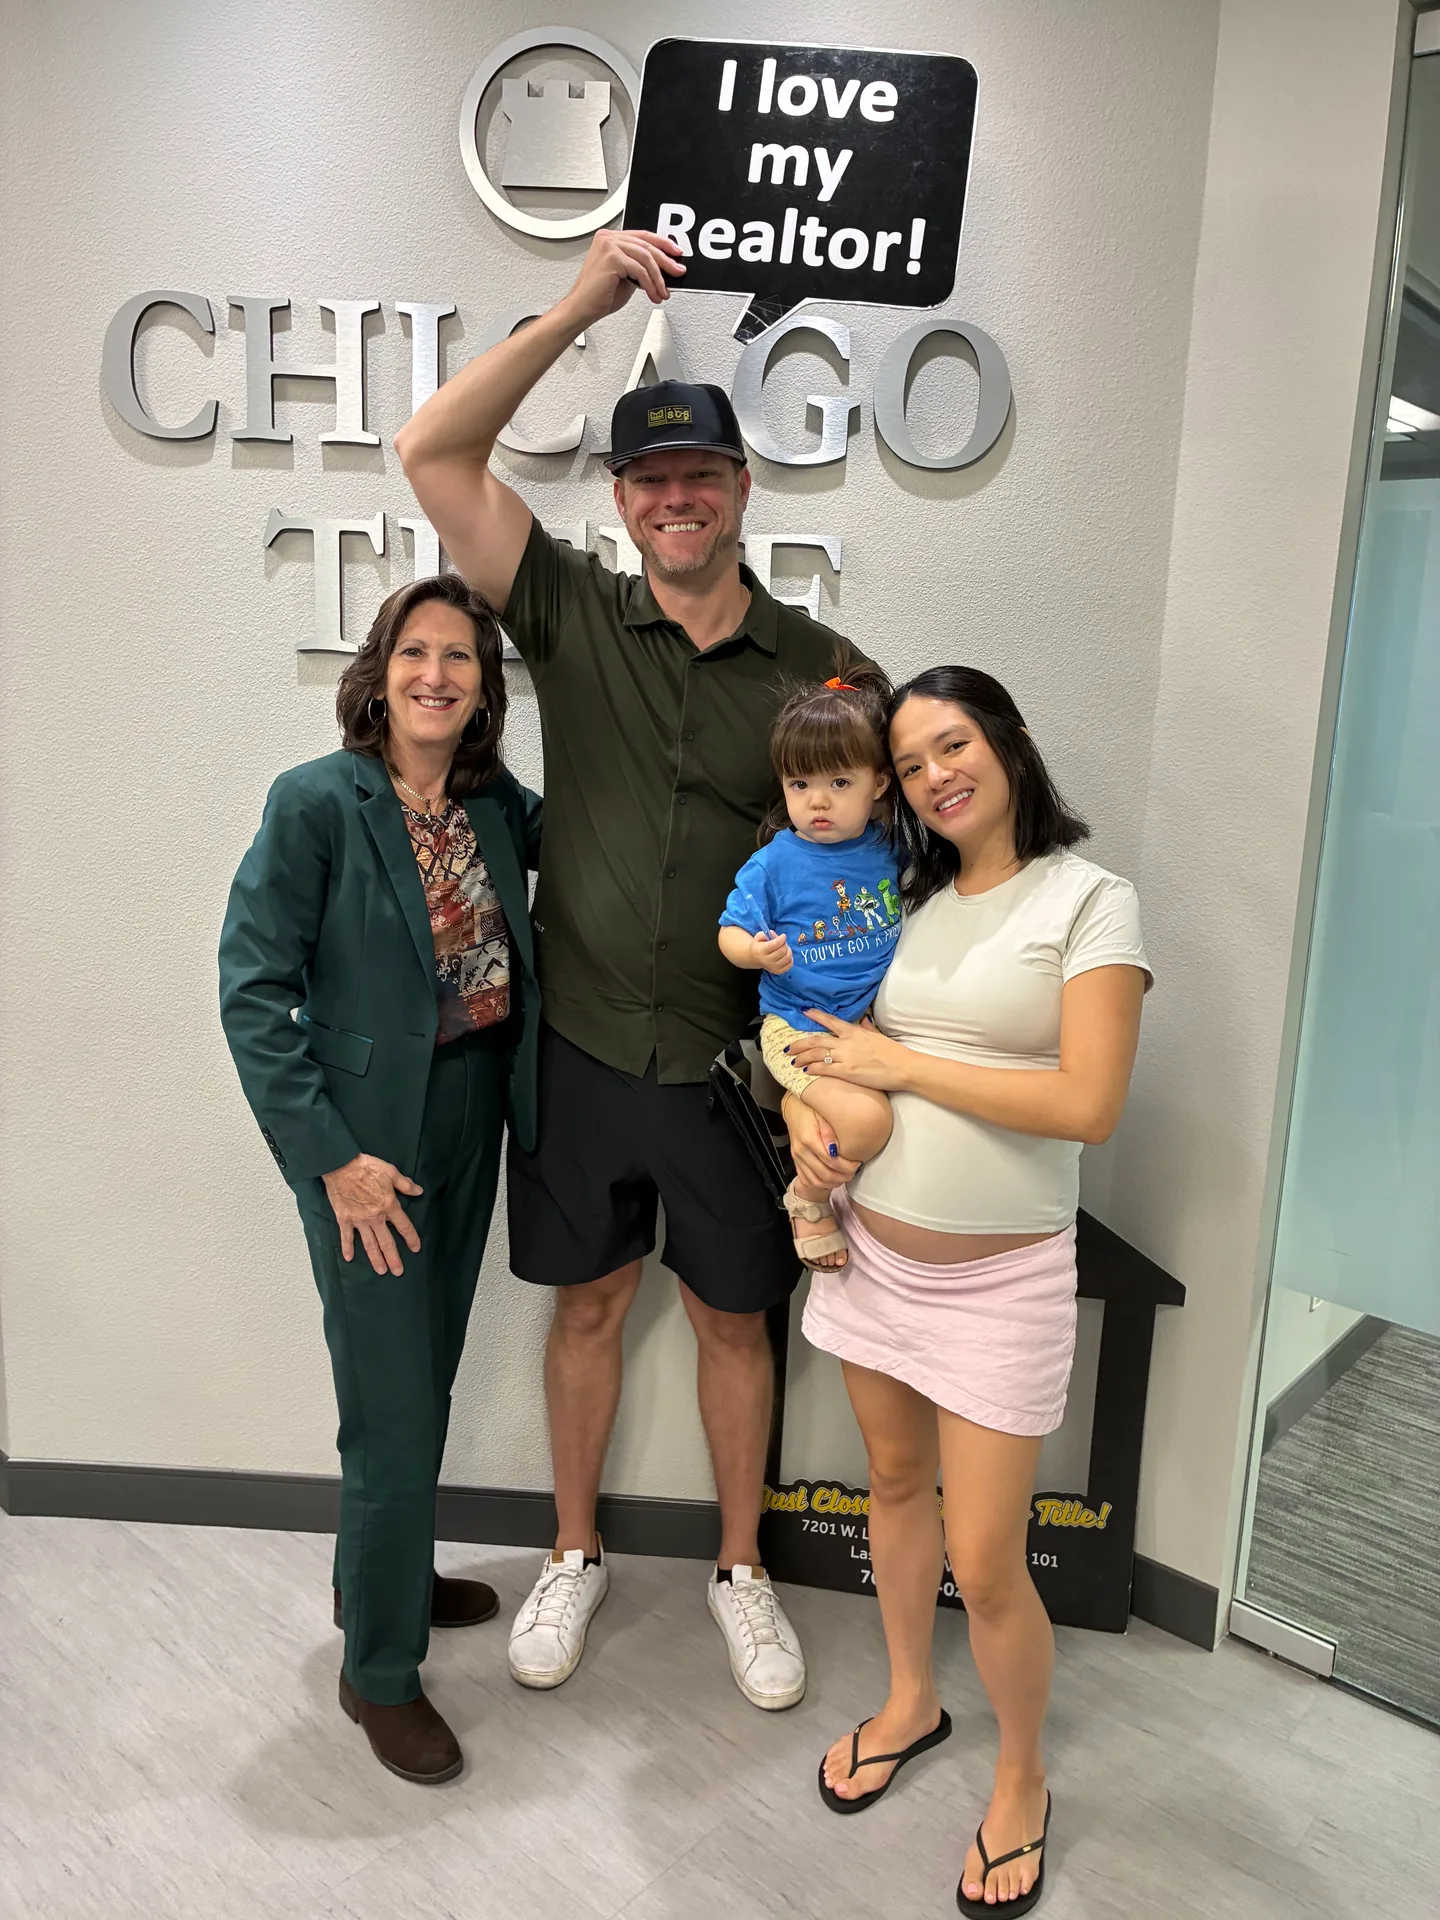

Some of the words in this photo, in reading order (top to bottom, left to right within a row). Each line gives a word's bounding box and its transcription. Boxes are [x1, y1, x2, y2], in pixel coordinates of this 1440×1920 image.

[718, 59, 738, 112] I
[757, 58, 899, 122] love
[748, 142, 853, 201] my
[656, 203, 926, 275] Realtor!
[800, 942, 844, 965] YOU'VE
[847, 935, 870, 954] GOT
[875, 933, 883, 947] A
[1035, 1499, 1112, 1529] Title!
[801, 1519, 837, 1536] 7201
[840, 1523, 859, 1540] W.
[1030, 1552, 1059, 1568] 101
